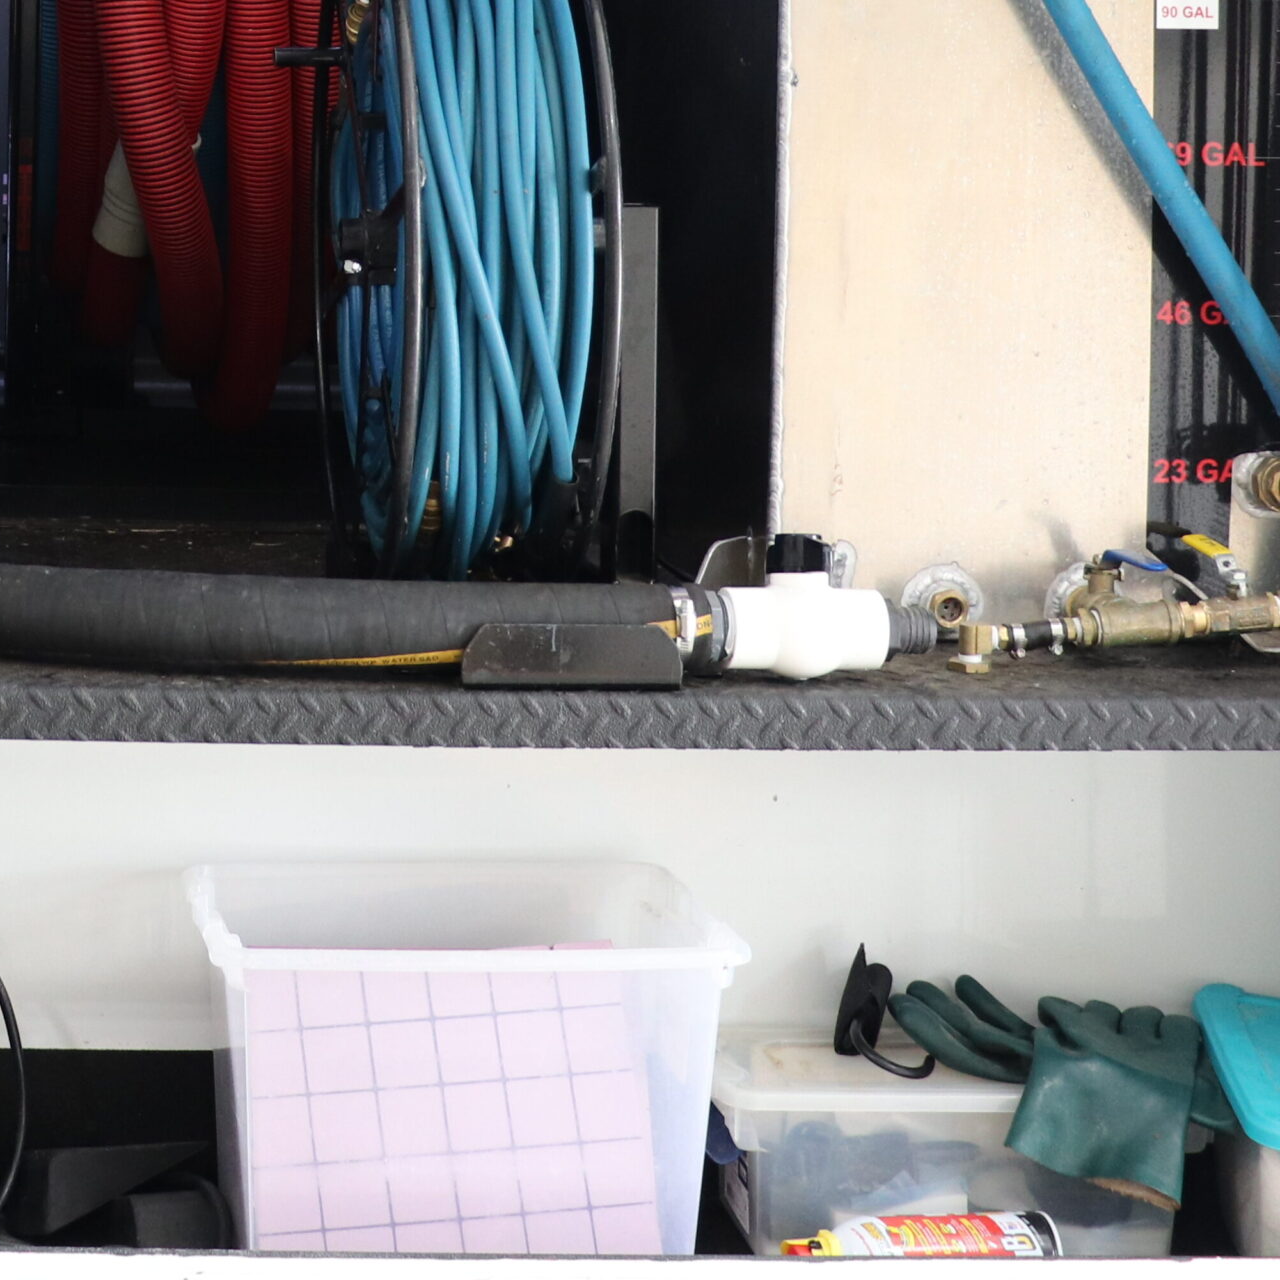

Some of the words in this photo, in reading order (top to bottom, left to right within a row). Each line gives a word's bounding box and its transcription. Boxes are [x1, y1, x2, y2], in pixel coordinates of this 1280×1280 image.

[1161, 6, 1178, 19] 90
[1182, 6, 1214, 19] GAL
[1168, 142, 1193, 166] 9
[1201, 141, 1266, 167] GAL
[1156, 300, 1192, 326] 46
[1153, 458, 1188, 484] 23
